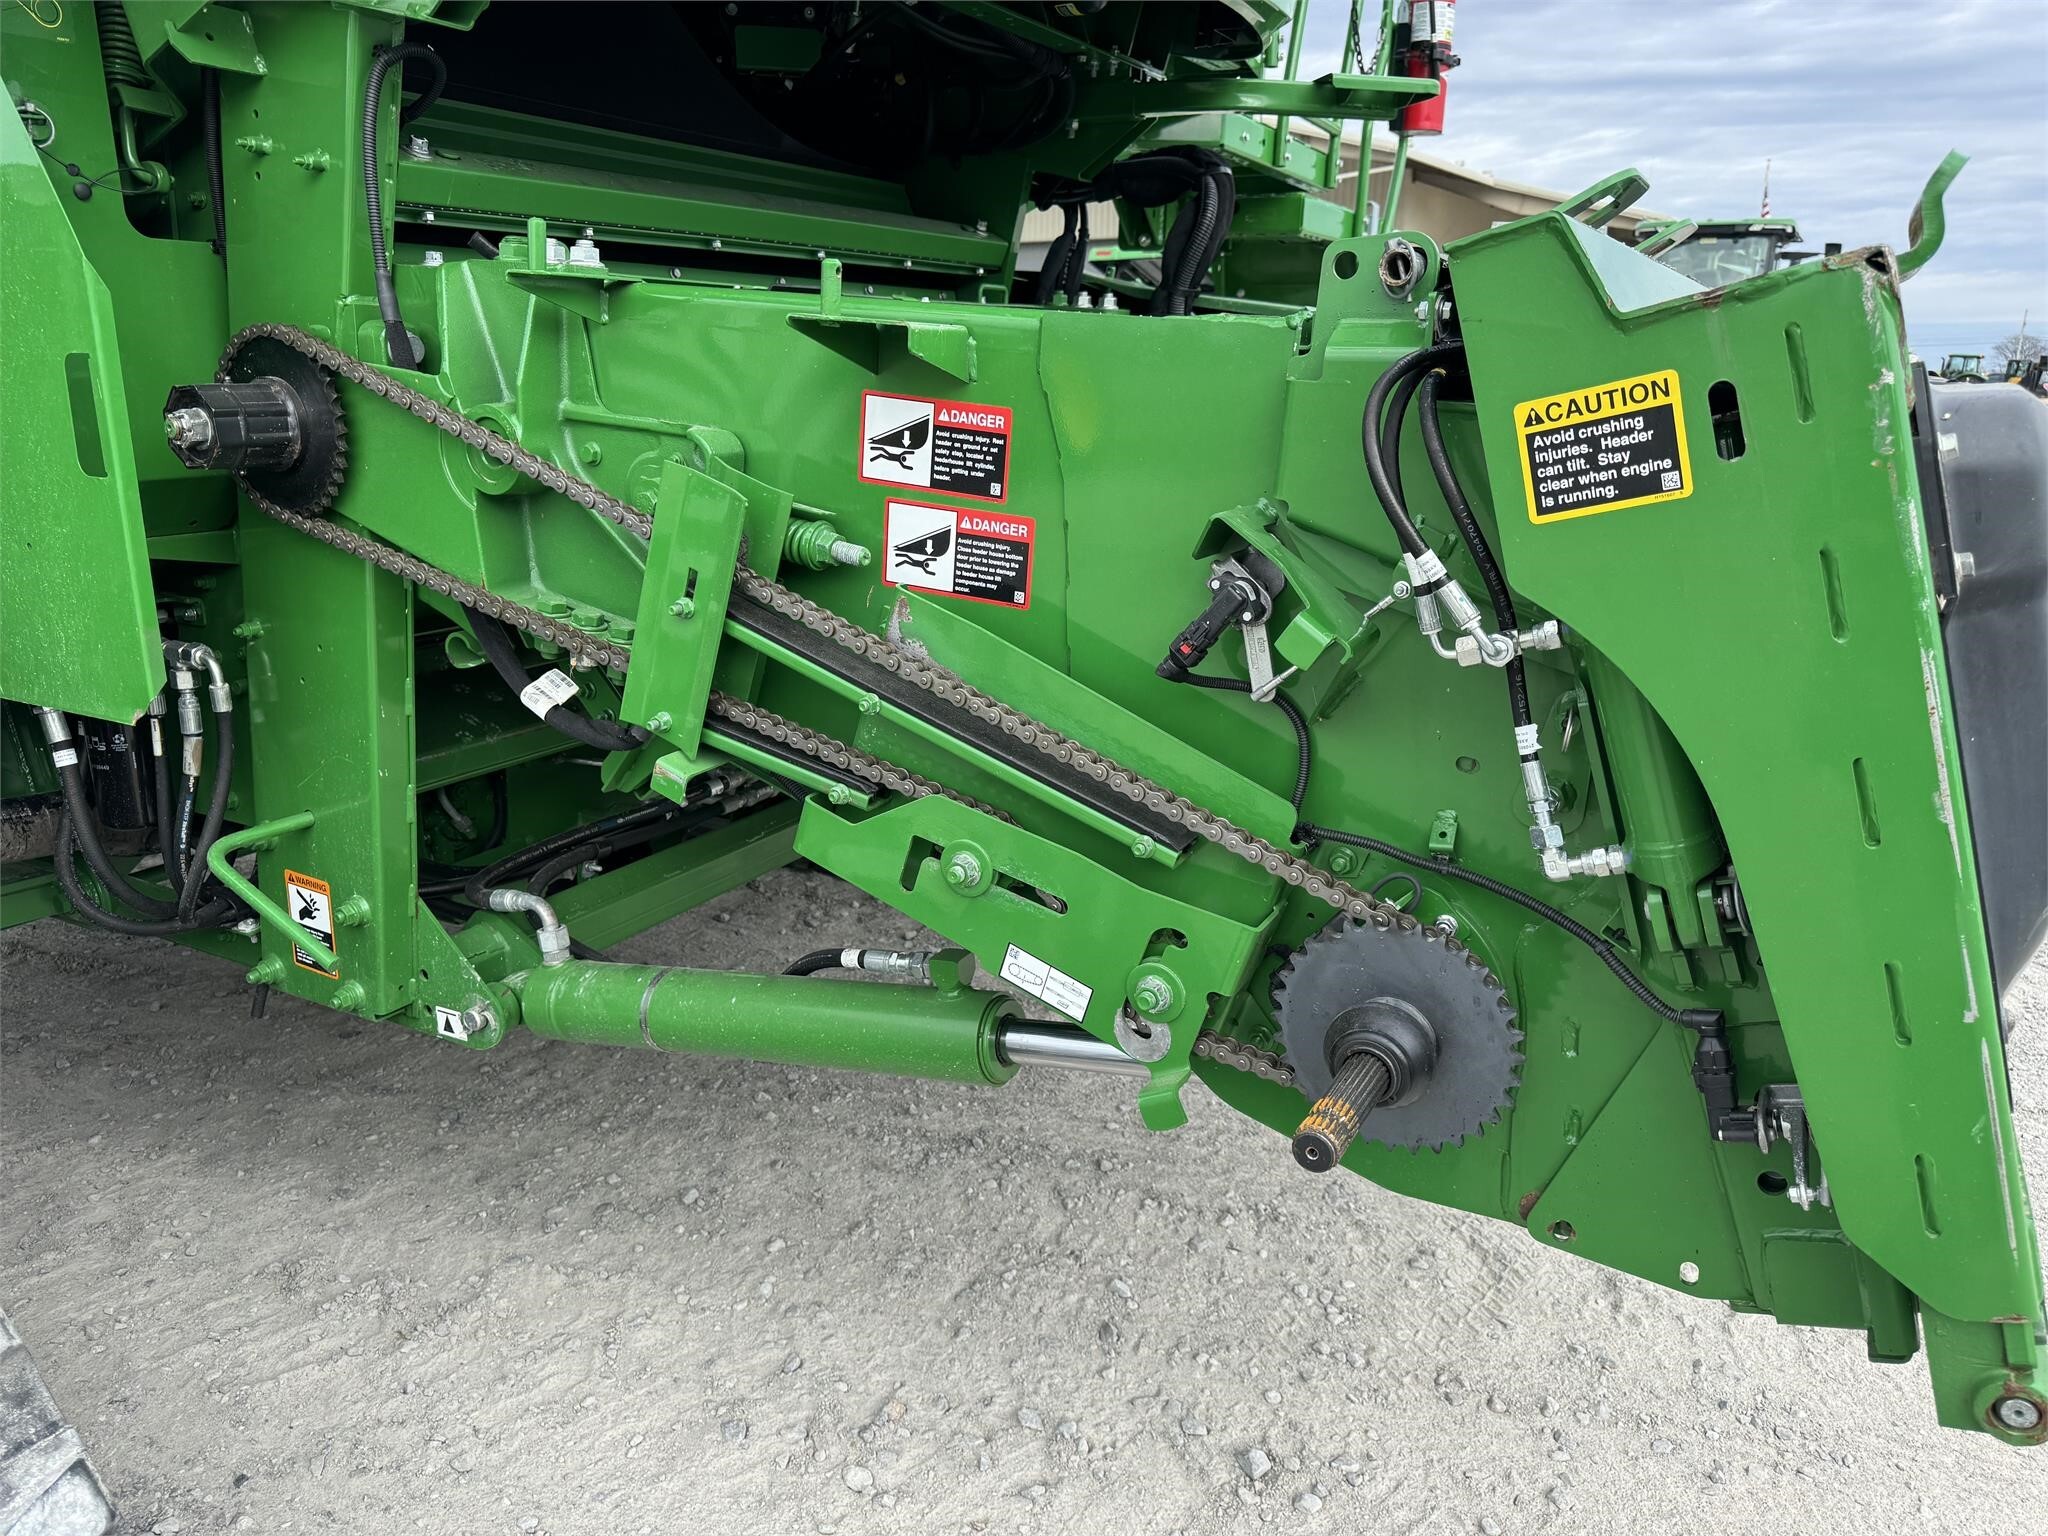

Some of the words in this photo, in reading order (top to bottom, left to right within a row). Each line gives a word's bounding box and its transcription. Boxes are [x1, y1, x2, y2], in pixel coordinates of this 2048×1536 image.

[1546, 378, 1670, 422] CAUTION
[951, 410, 1004, 428] DANGER
[1533, 430, 1575, 448] Avoid
[1579, 416, 1644, 439] crushing
[1535, 444, 1593, 463] injuries.
[1600, 430, 1654, 449] Header
[1538, 464, 1563, 477] can
[1566, 458, 1590, 473] tilt.
[1598, 451, 1630, 466] Stay
[1540, 477, 1574, 492] clear
[1578, 470, 1617, 485] when
[1621, 458, 1672, 476] engine
[1542, 495, 1554, 508] is
[1558, 484, 1619, 505] running.
[973, 518, 1028, 537] DANGER
[973, 541, 994, 549] crushing
[989, 559, 1010, 568] lowering
[295, 876, 326, 891] WARNING
